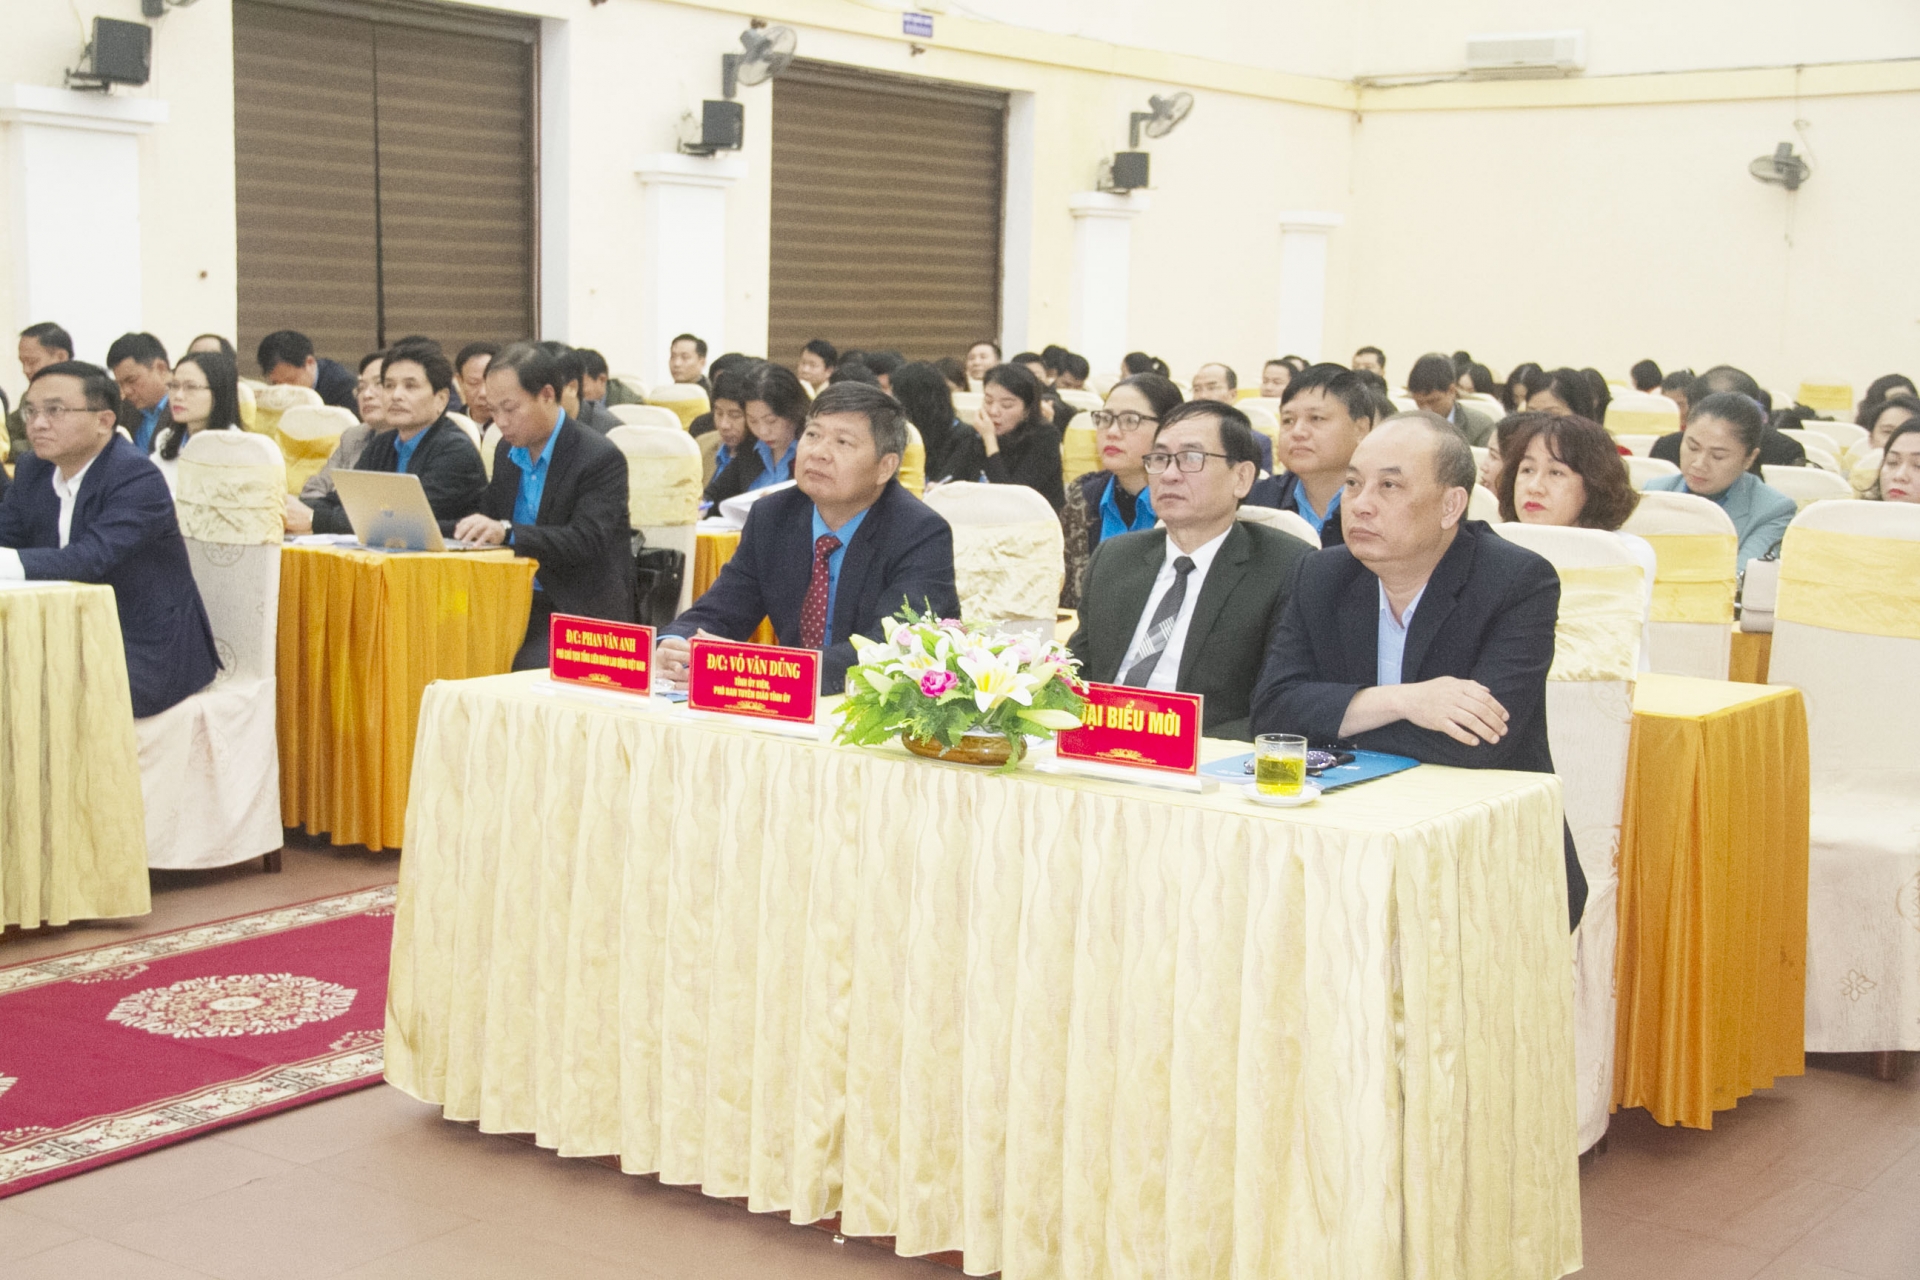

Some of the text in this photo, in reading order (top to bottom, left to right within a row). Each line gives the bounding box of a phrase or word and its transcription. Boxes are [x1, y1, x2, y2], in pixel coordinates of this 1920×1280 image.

[582, 631, 602, 647] PHAN
[603, 632, 618, 650] VĂN
[619, 637, 636, 653] ANH
[707, 652, 728, 671] Đ/C:
[746, 655, 768, 675] VĂN
[769, 657, 801, 680] DŨNG
[1106, 700, 1144, 732] BIỂU
[1147, 707, 1181, 737] MỜI
